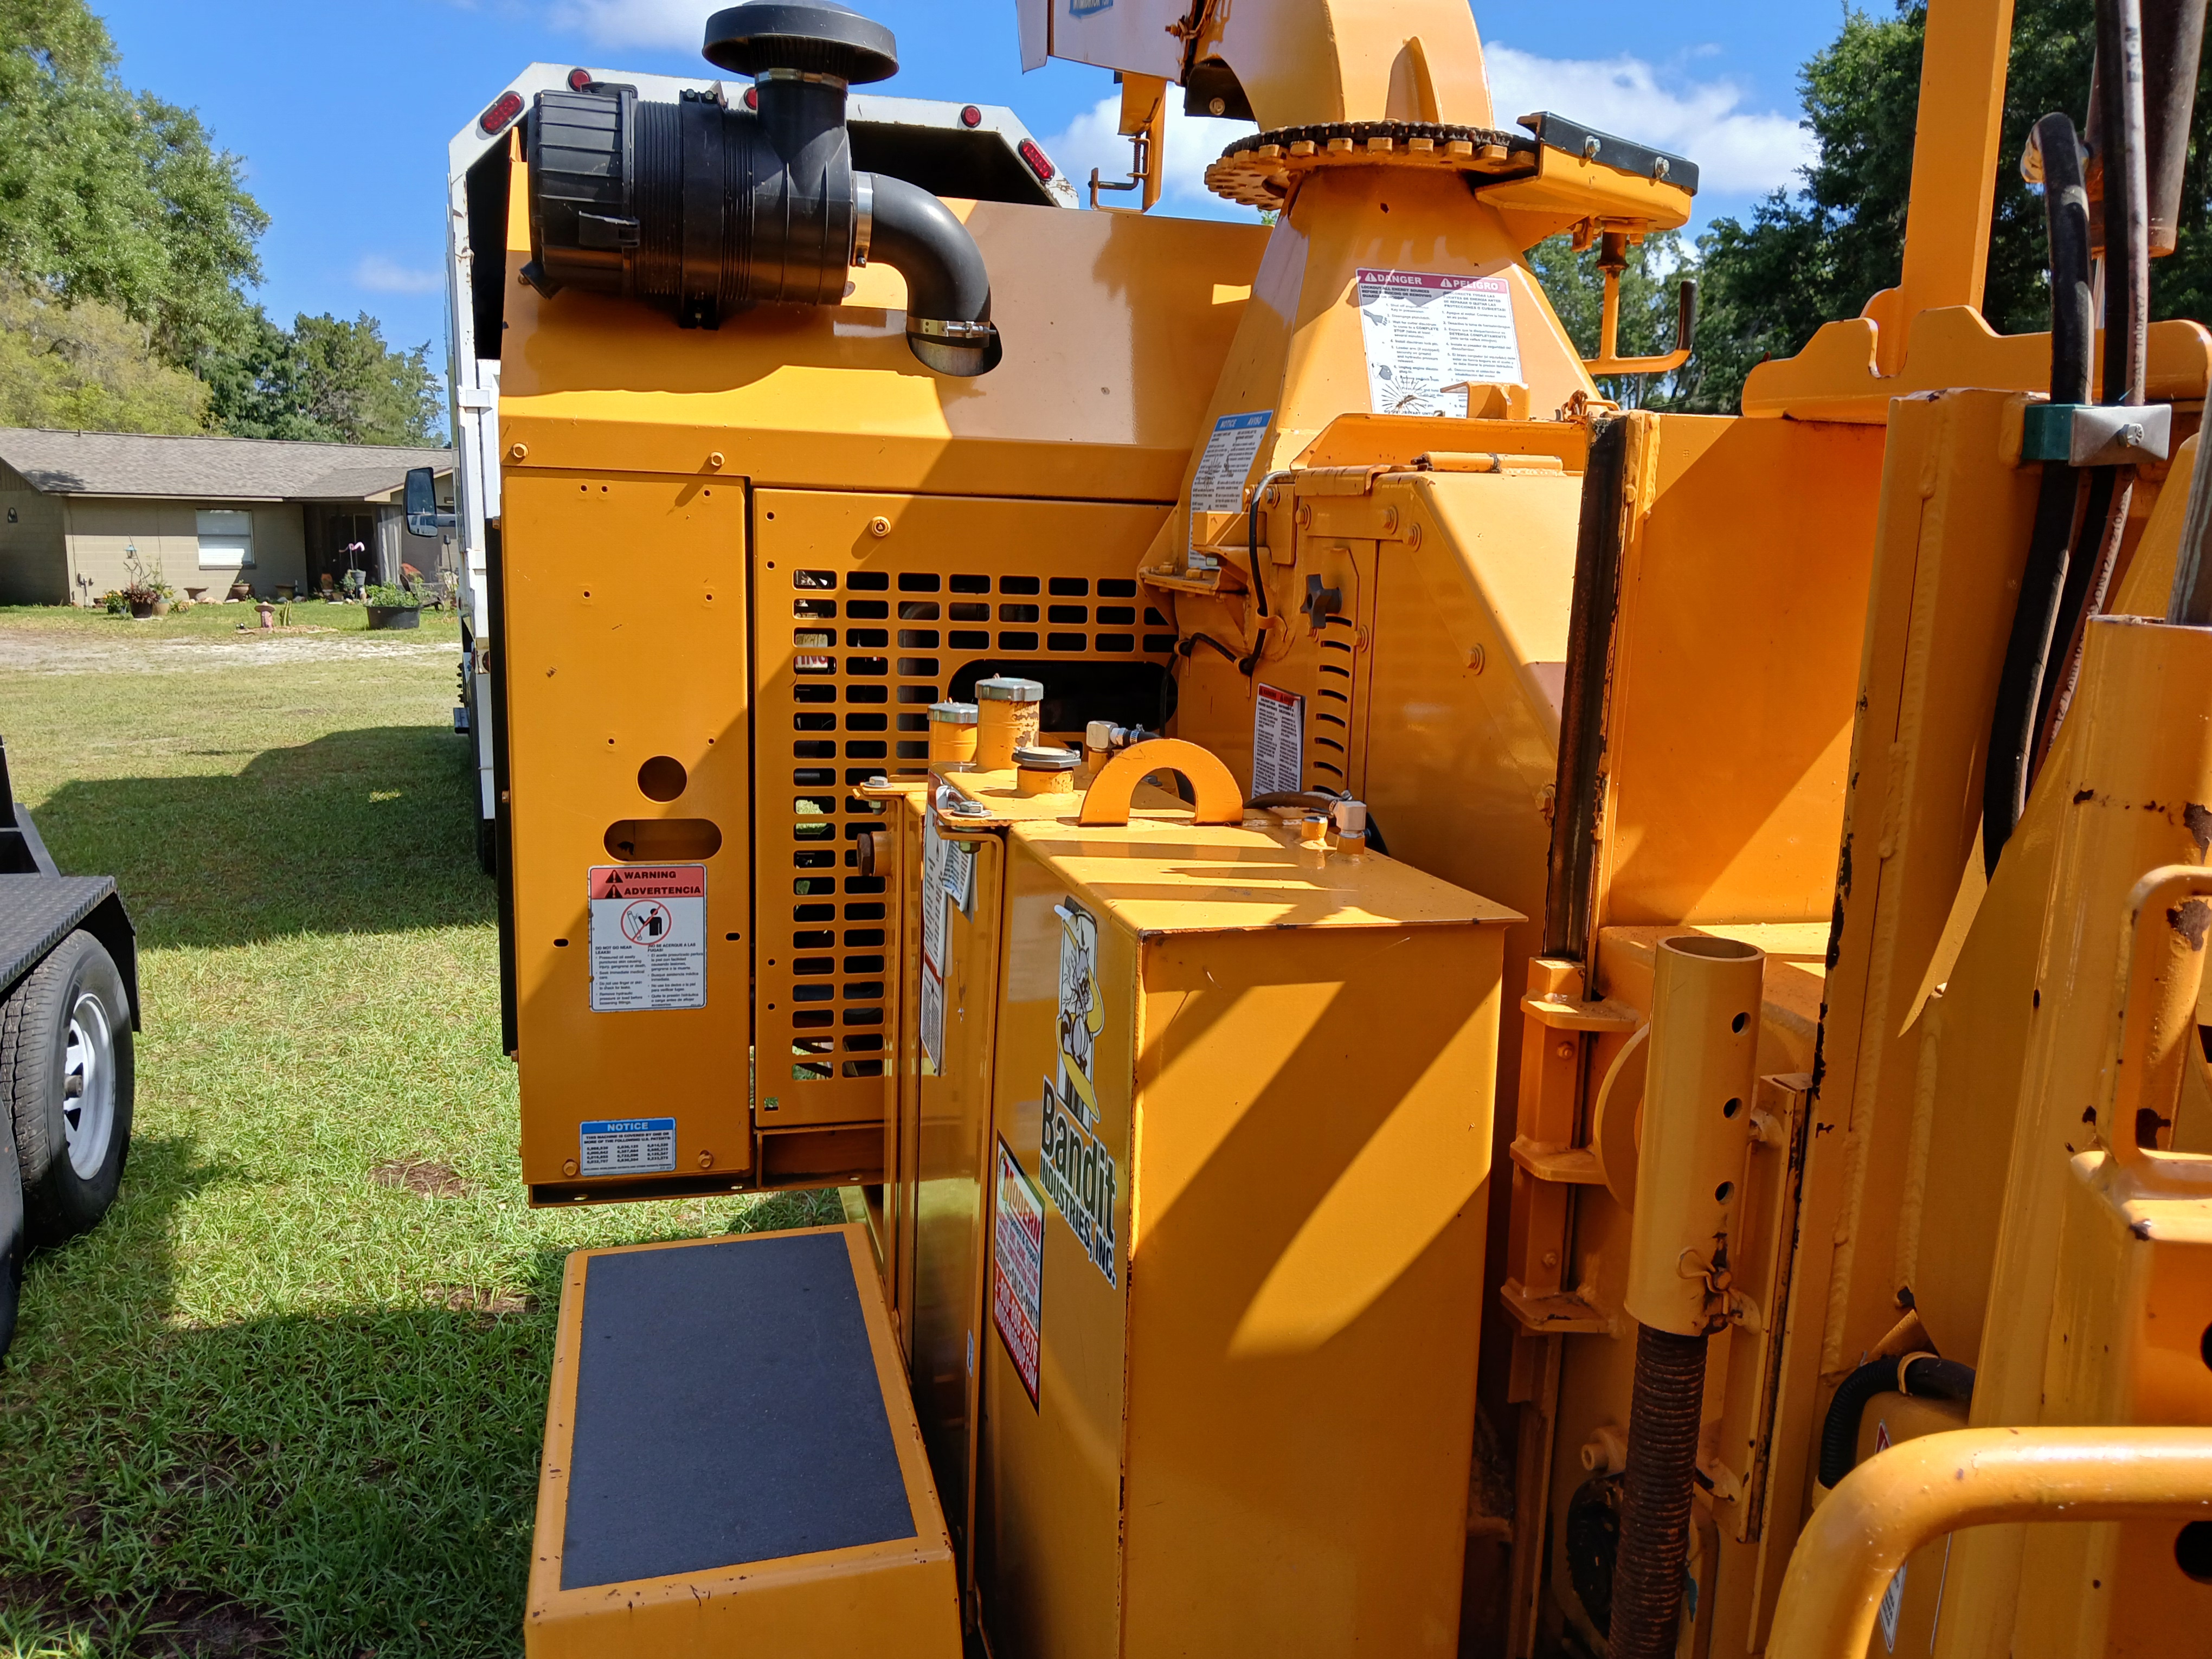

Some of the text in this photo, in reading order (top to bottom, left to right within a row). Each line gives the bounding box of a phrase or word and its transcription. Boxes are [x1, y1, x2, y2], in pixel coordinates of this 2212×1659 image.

[1377, 274, 1422, 285] DANGER
[1454, 280, 1498, 290] PELIGRO
[1220, 416, 1262, 428] NOTICE AVISO
[624, 871, 677, 879] WARNING
[623, 886, 701, 895] ADVERTENCIA
[607, 1122, 648, 1131] NOTICE
[1041, 1079, 1116, 1245] Bandit
[1003, 1156, 1040, 1246] MODERN
[1040, 1154, 1116, 1287] INDUSTRIES, INC.
[1026, 1239, 1039, 1268] Supply
[995, 1267, 1038, 1367] 1-800-866-3376
[995, 1292, 1037, 1394] MODERNGROUP.COM
